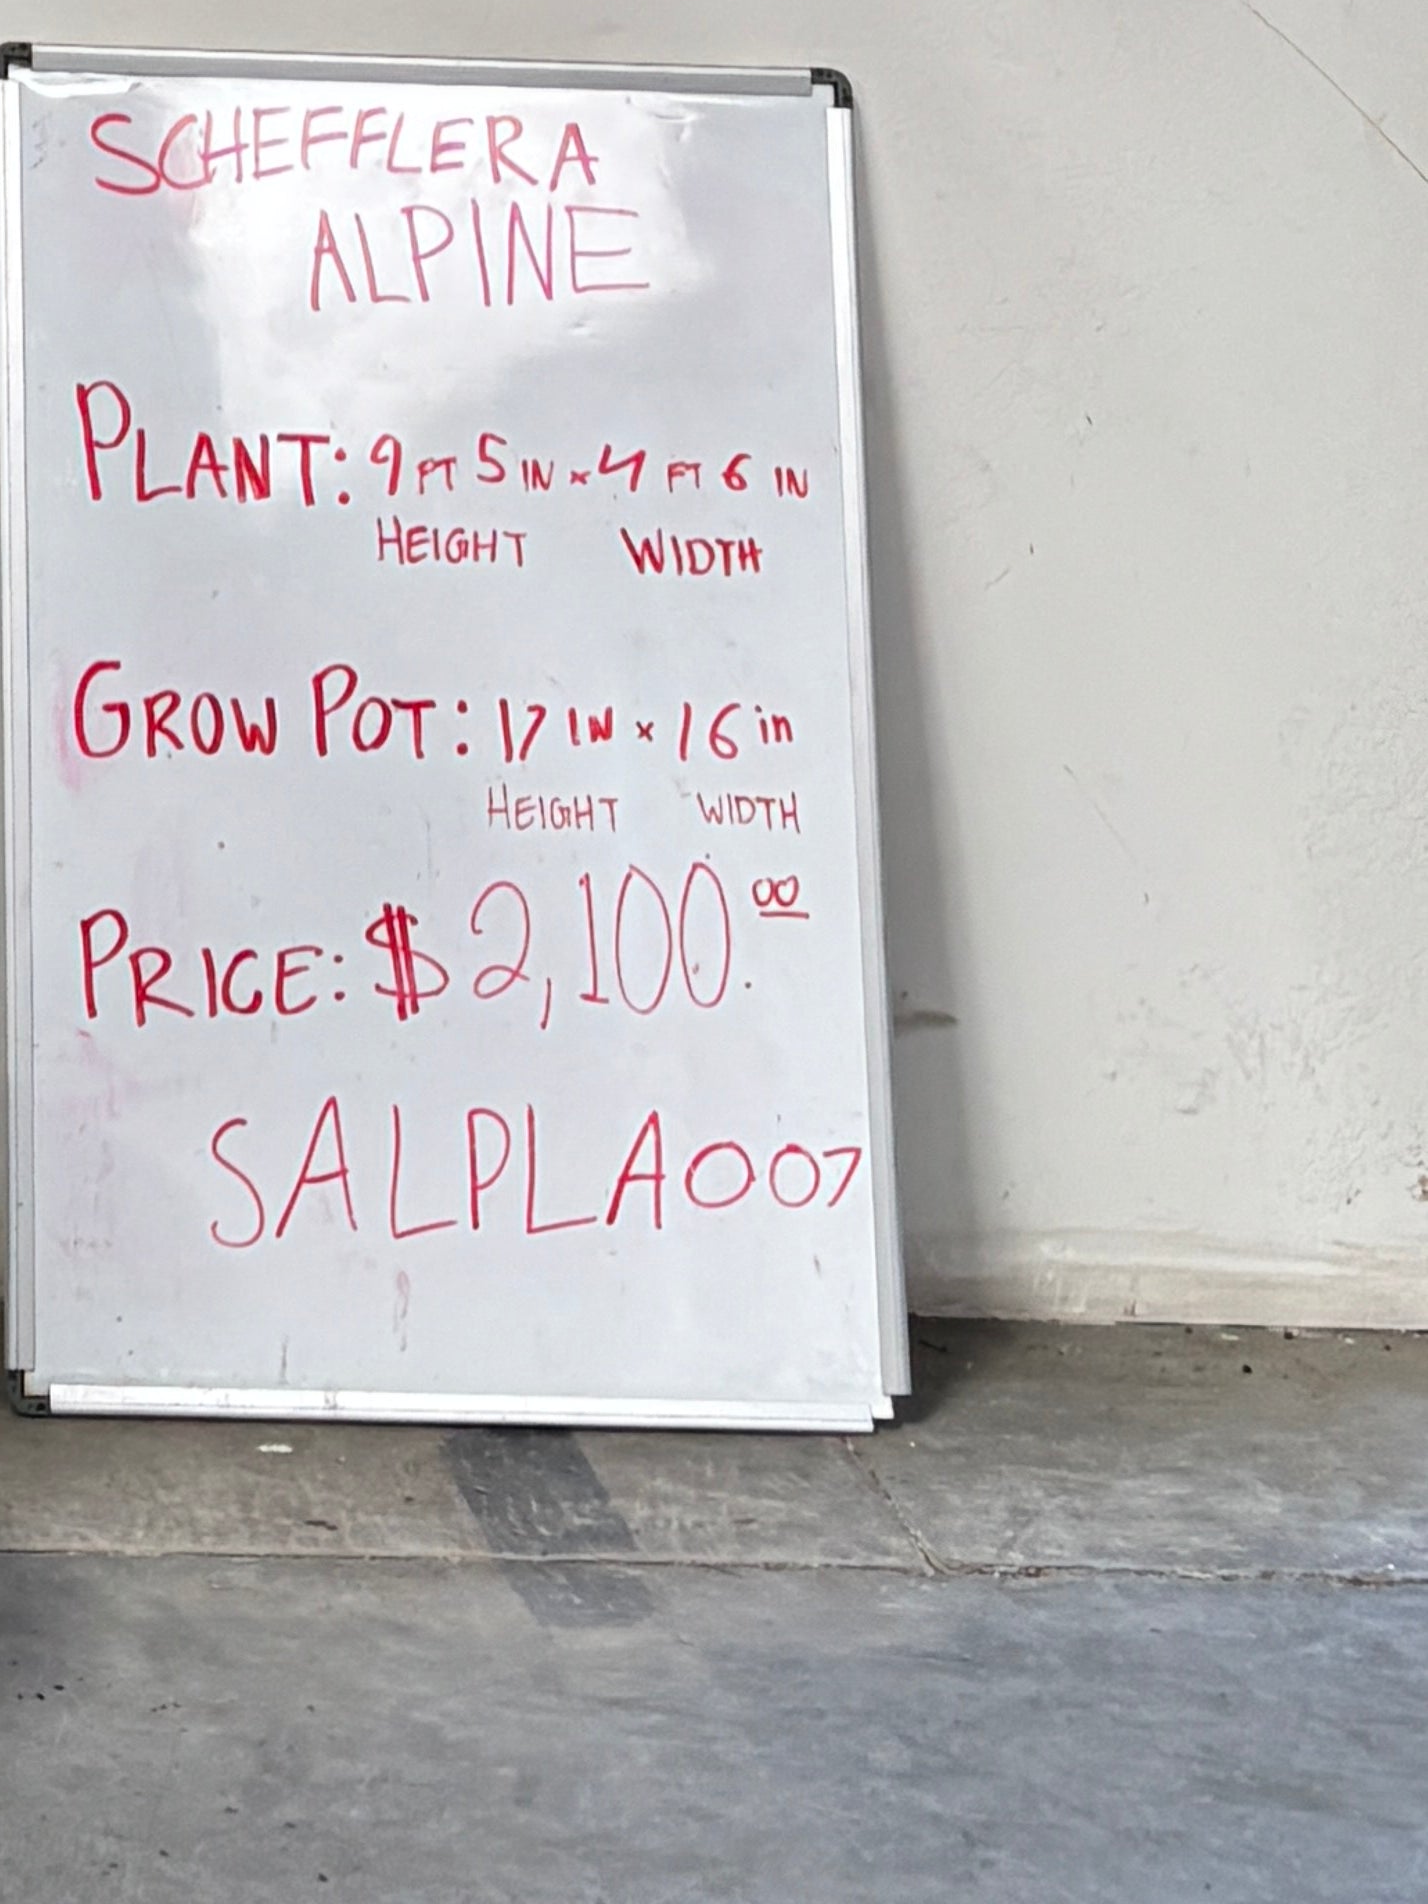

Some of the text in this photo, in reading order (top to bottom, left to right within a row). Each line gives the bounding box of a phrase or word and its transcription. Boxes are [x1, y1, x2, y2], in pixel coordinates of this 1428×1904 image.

[89, 106, 599, 195] SCHEFFLERA
[308, 198, 650, 311] ALPINE
[75, 381, 351, 508] PLANT:
[369, 433, 403, 497] 9
[476, 431, 508, 485] 5
[520, 458, 554, 493] IN
[667, 461, 702, 493] FT
[721, 452, 751, 493] 6
[774, 466, 809, 500] IN
[376, 516, 764, 578] HEIGHT WIDTH
[72, 659, 279, 761] GROW
[310, 663, 469, 761] POT:
[498, 698, 547, 764] 17
[676, 702, 741, 762] 16
[755, 705, 794, 745] in
[486, 784, 802, 835] HEIGHT WIDTH
[79, 907, 346, 1029] PRICE:
[209, 1096, 864, 1248] SALPLA007
